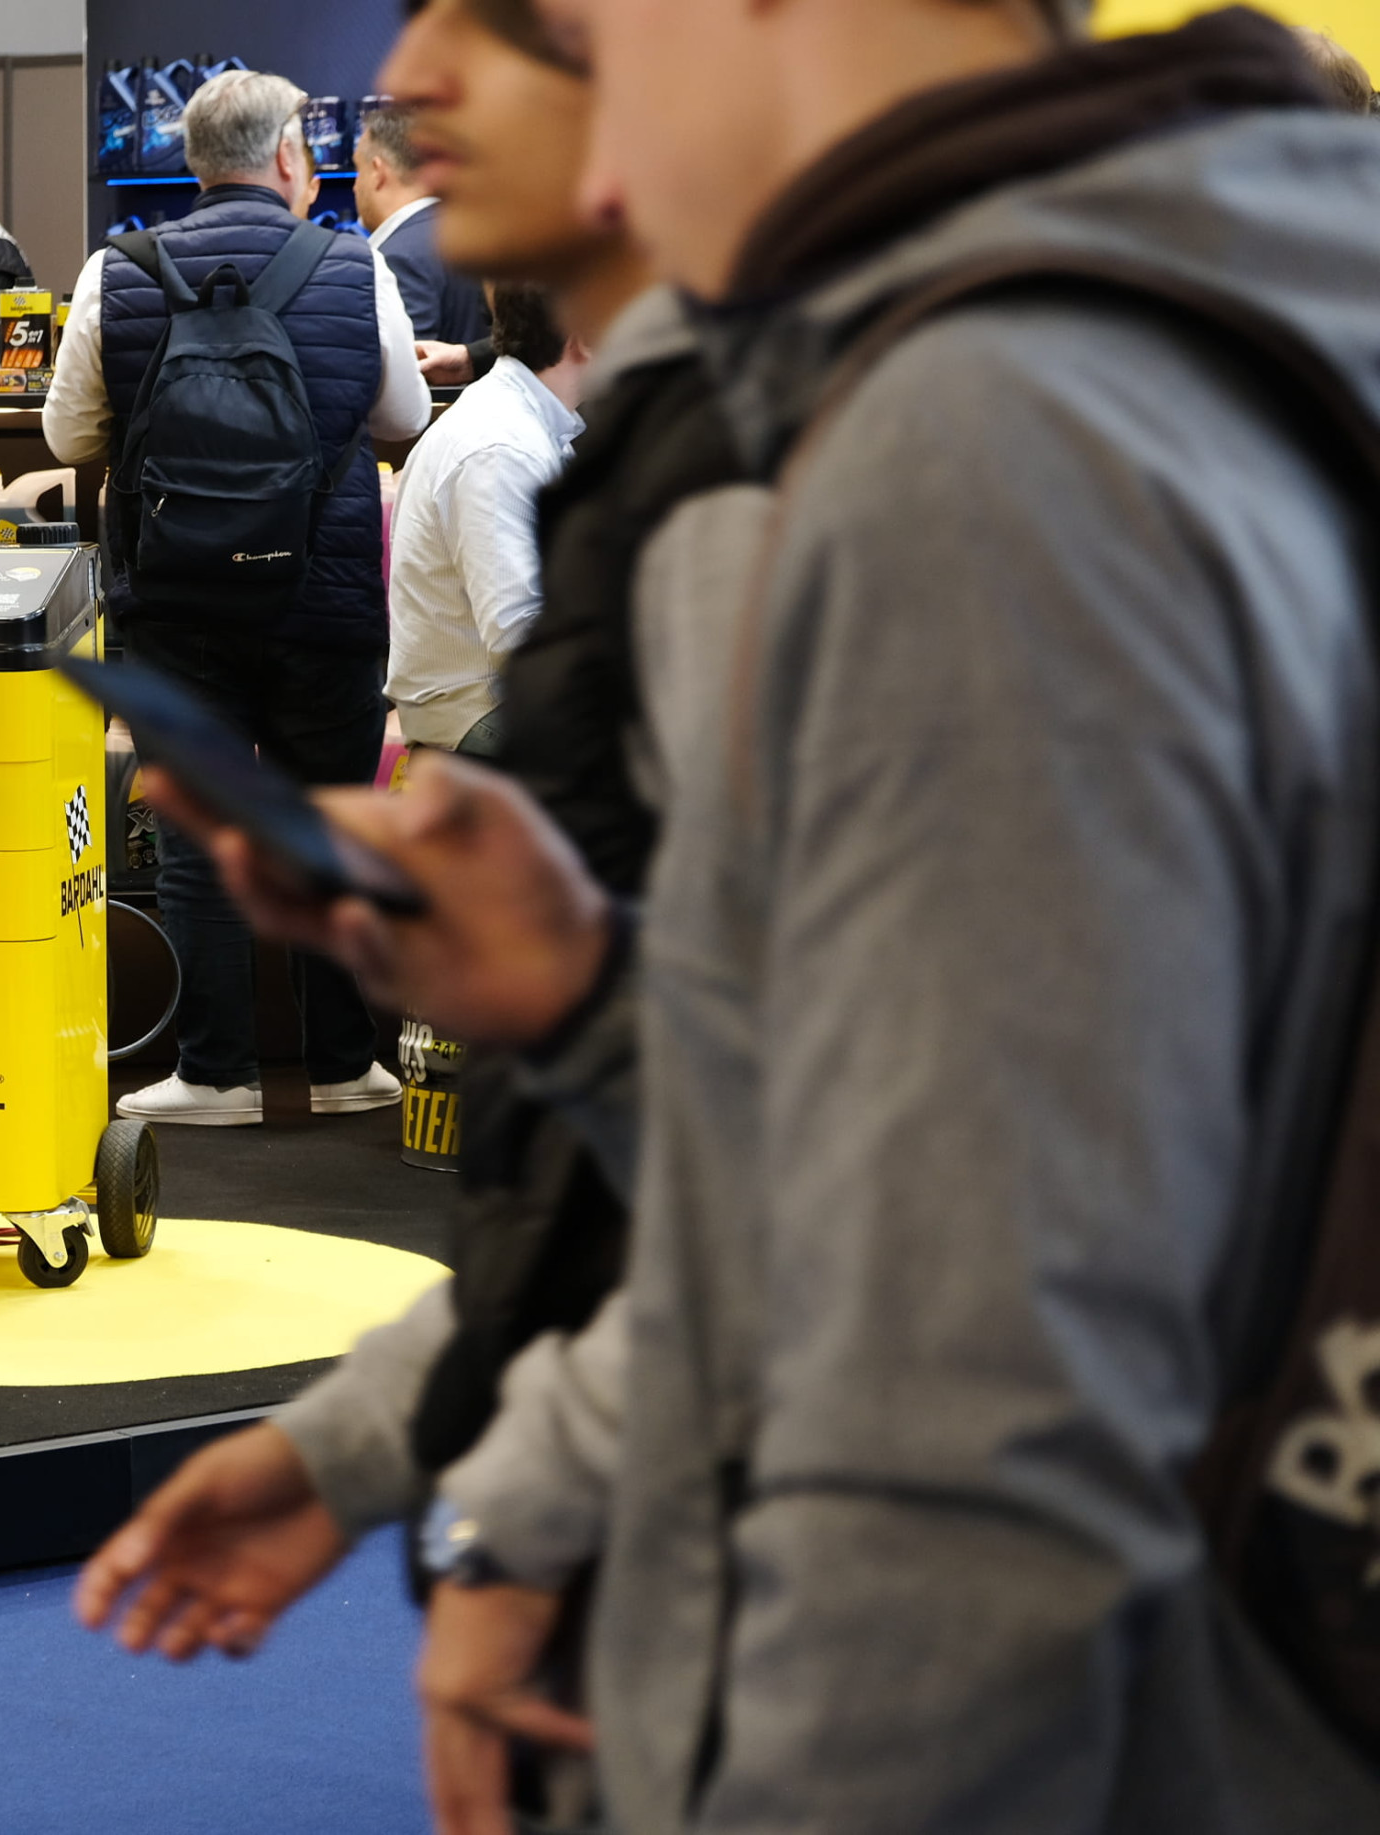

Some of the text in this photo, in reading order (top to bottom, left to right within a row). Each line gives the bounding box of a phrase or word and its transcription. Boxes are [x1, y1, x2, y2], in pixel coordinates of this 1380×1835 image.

[9, 320, 30, 347] 5
[232, 550, 292, 562] Champion
[61, 864, 104, 917] BARDAHL
